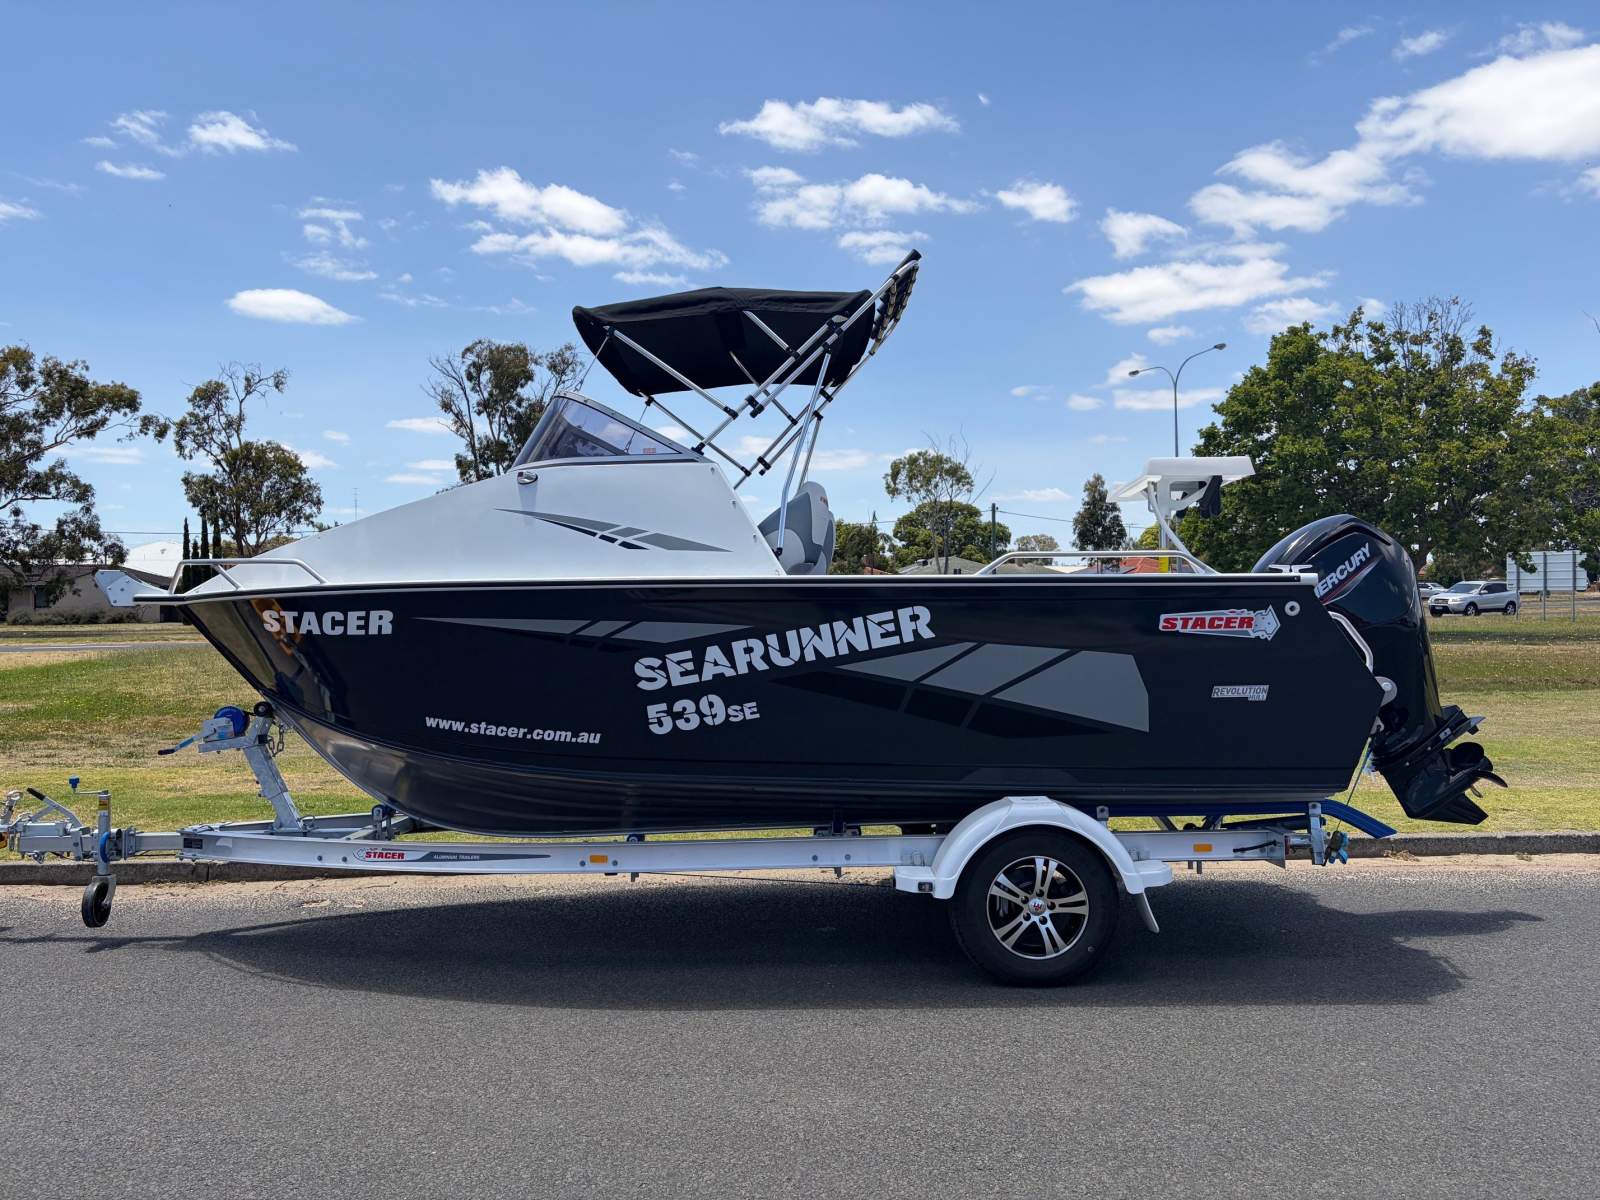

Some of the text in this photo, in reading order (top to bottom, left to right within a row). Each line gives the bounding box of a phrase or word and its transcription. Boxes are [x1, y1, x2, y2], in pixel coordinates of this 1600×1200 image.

[262, 609, 394, 636] STACER
[1161, 616, 1254, 630] STACER
[634, 605, 936, 691] SEARUNNER
[1212, 687, 1268, 697] REVOLUTION
[425, 716, 601, 744] www.stacer.com.au
[365, 851, 405, 860] STACER
